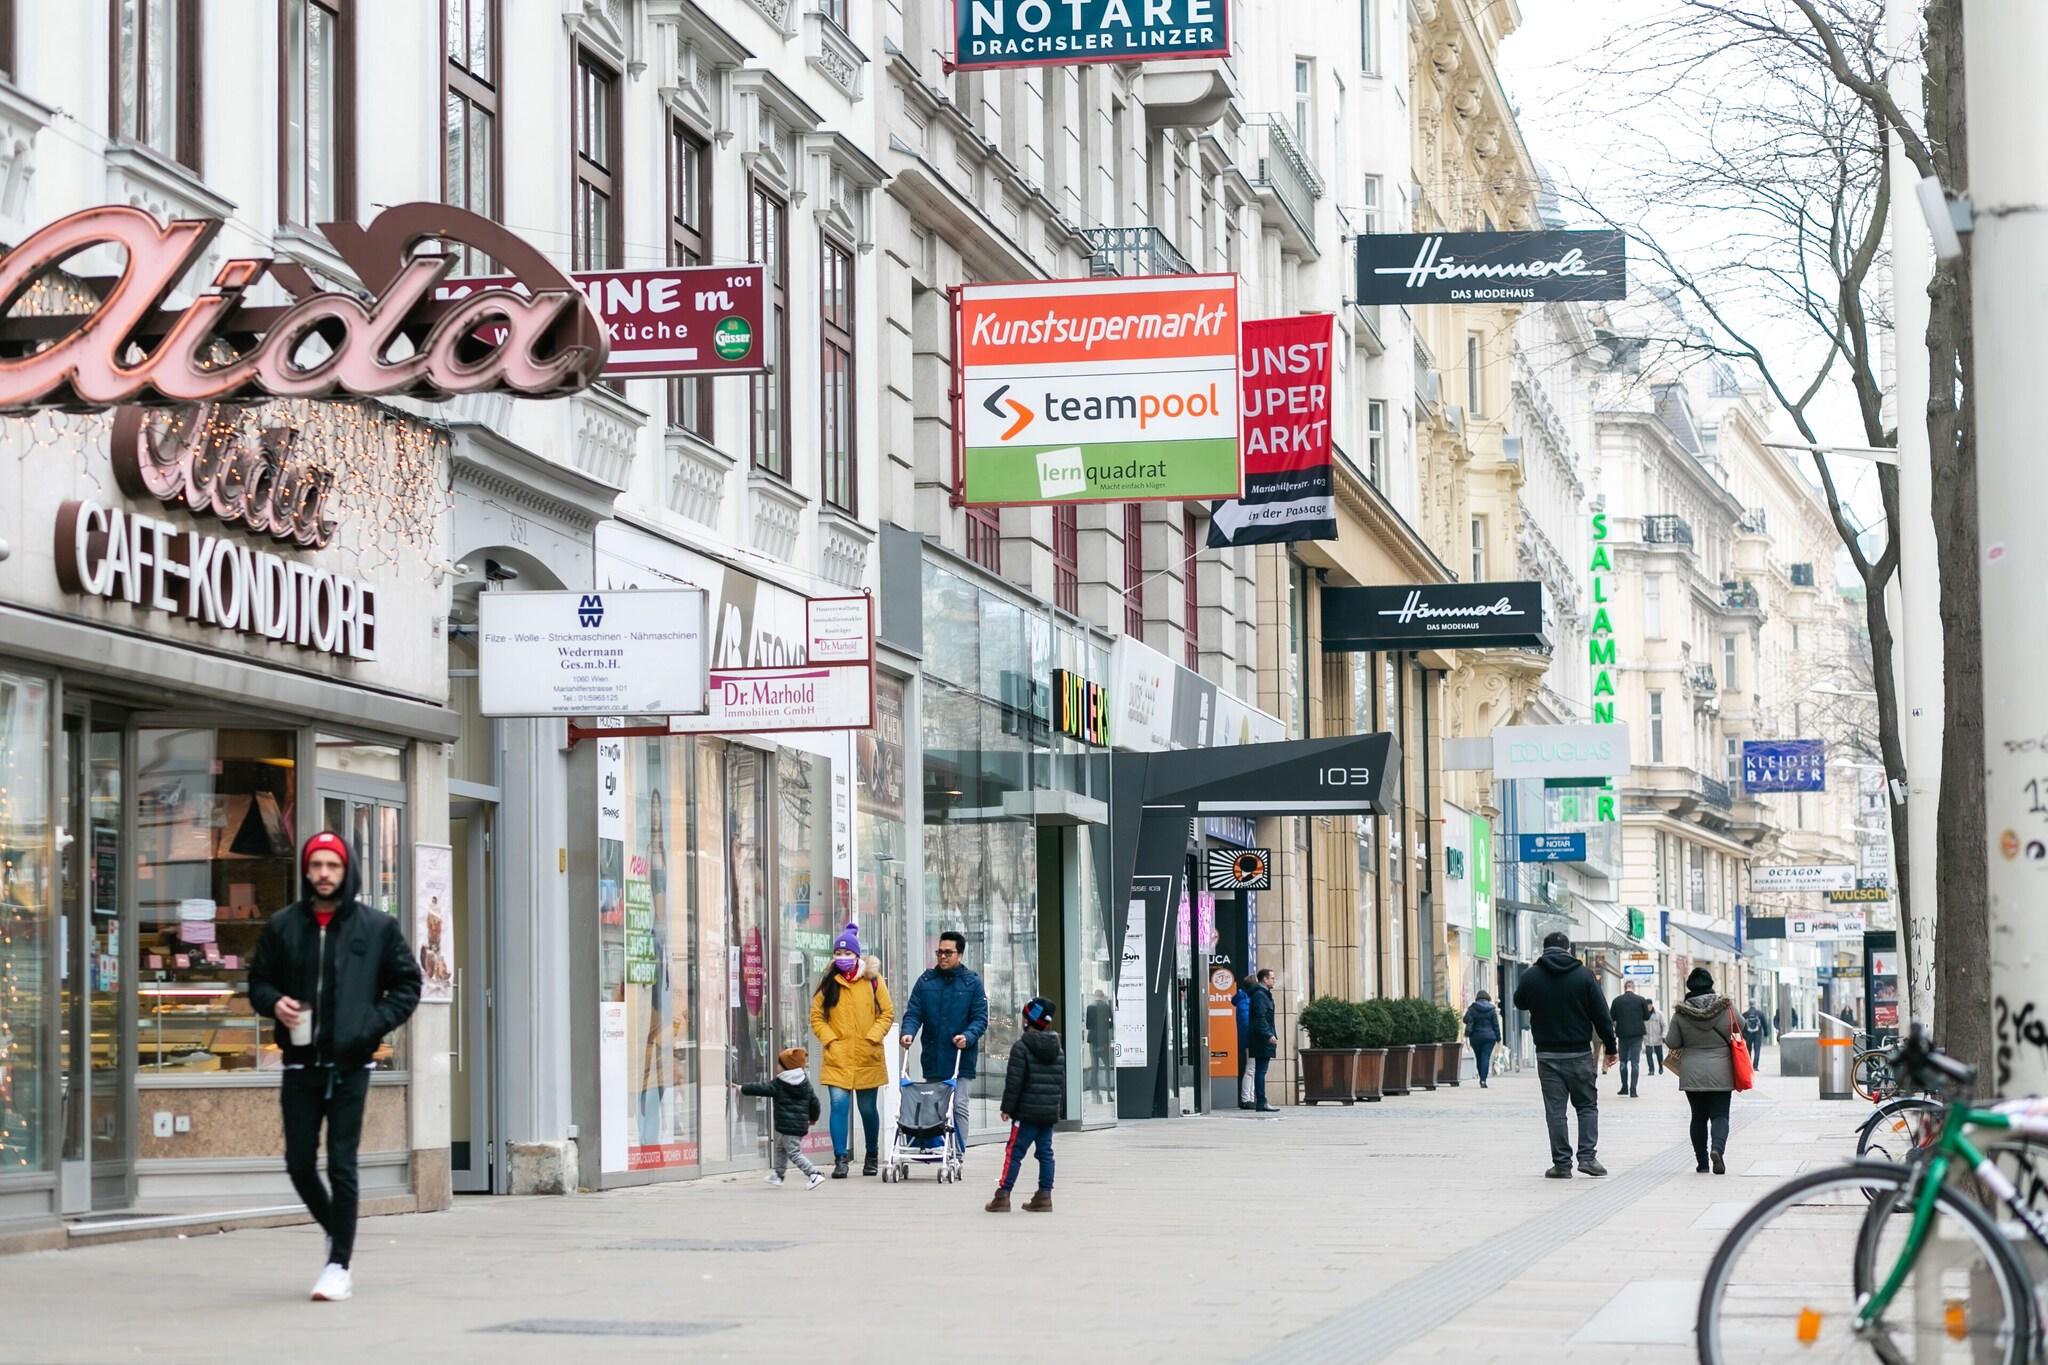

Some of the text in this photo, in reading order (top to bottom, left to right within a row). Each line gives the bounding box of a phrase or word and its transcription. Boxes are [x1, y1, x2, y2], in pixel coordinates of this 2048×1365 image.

[972, 0, 1214, 35] NOTARE
[972, 27, 1214, 56] DRACHSLER LINZER
[1451, 288, 1535, 299] DAS MODEHAUS
[971, 302, 1227, 351] Kunstsupermarkt
[1045, 383, 1219, 430] teampool
[1100, 483, 1121, 491] Macht
[1121, 482, 1145, 490] einfach
[1313, 478, 1326, 487] 103
[1248, 504, 1327, 520] in der Passage
[1441, 622, 1480, 630] MODEHAUS
[485, 631, 698, 642] Filze Wolle Strickmaschinen Nähmaschinen
[558, 646, 624, 657] Wedermann
[560, 659, 621, 670] Ges.m.b.H.
[1590, 513, 1616, 822] SALAMANR
[615, 684, 627, 692] 101
[724, 681, 814, 706] Dr. Marhold
[724, 706, 815, 718] Immobilien GmbH
[1061, 671, 1110, 747] BUTLERS
[1510, 740, 1612, 763] DOUGLAS
[1747, 754, 1820, 769] KLEIDER
[1319, 768, 1369, 785] 103
[1747, 768, 1822, 783] BAUER
[1546, 840, 1571, 848] NOTAR
[1768, 868, 1823, 877] OCTAGON
